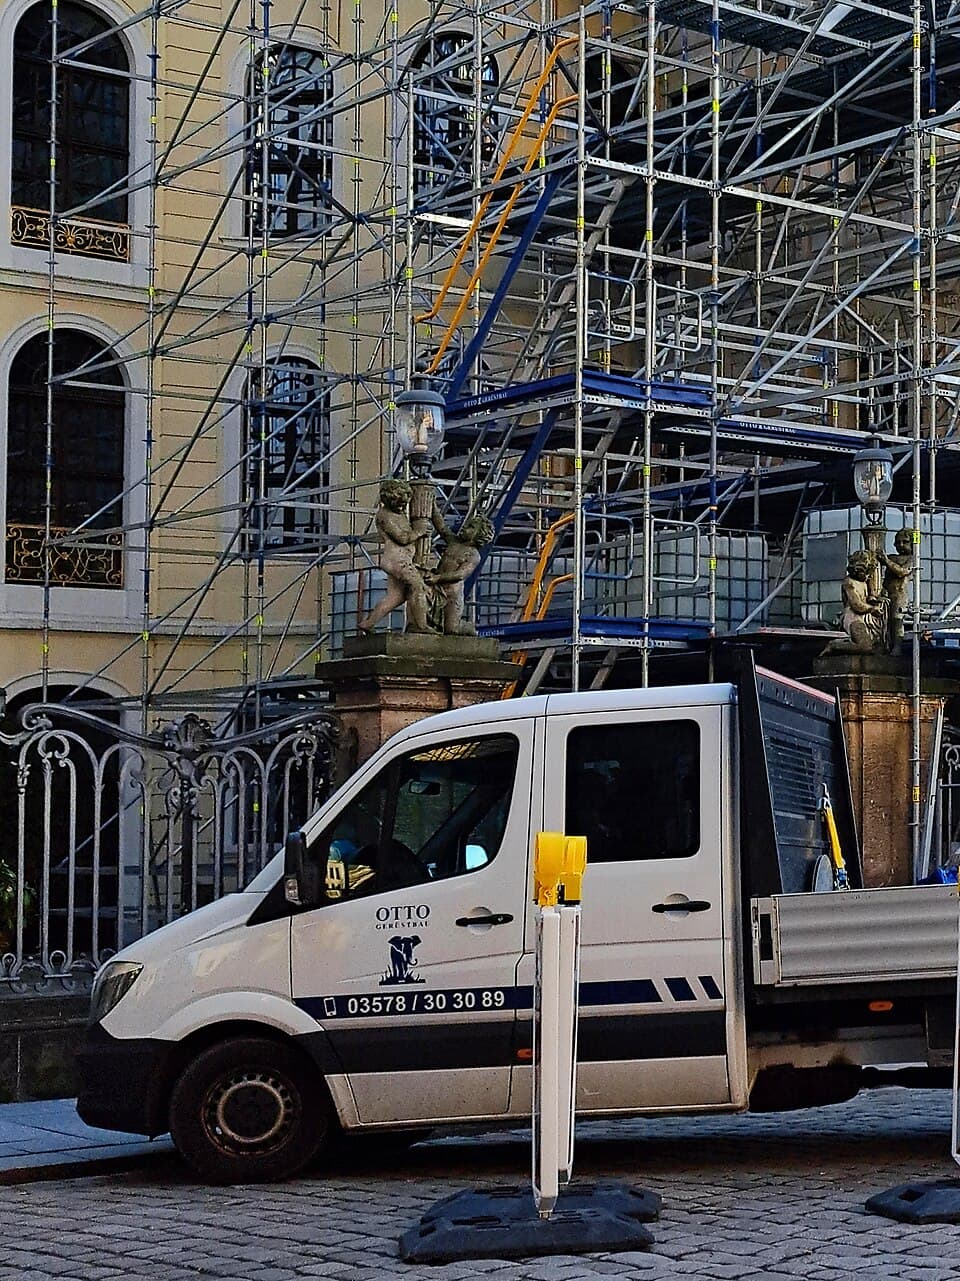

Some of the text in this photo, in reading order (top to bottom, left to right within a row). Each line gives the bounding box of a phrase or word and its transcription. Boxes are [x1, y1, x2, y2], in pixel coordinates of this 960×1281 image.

[375, 904, 431, 922] OTTO
[347, 990, 506, 1014] 03578 / 30 30 89
